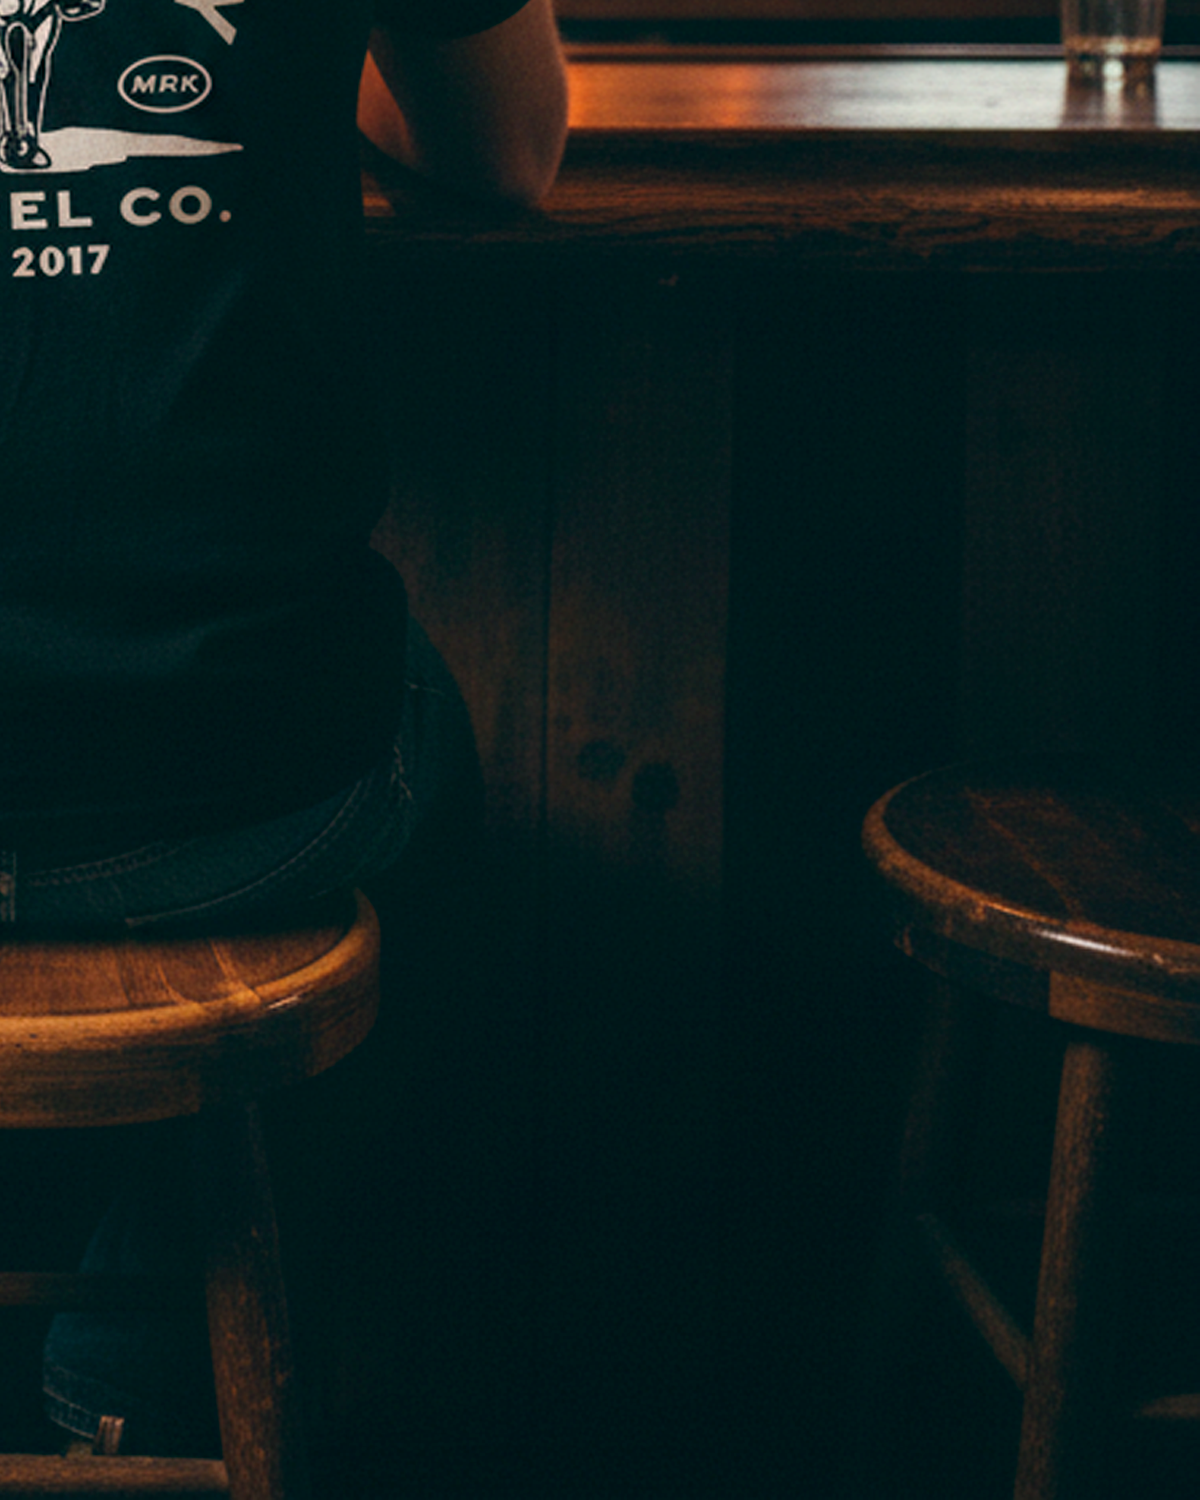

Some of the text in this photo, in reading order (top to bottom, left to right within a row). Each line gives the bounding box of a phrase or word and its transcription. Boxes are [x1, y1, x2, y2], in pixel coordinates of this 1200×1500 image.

[130, 73, 199, 93] MRK
[120, 186, 232, 226] CO.
[12, 245, 110, 277] 2017
